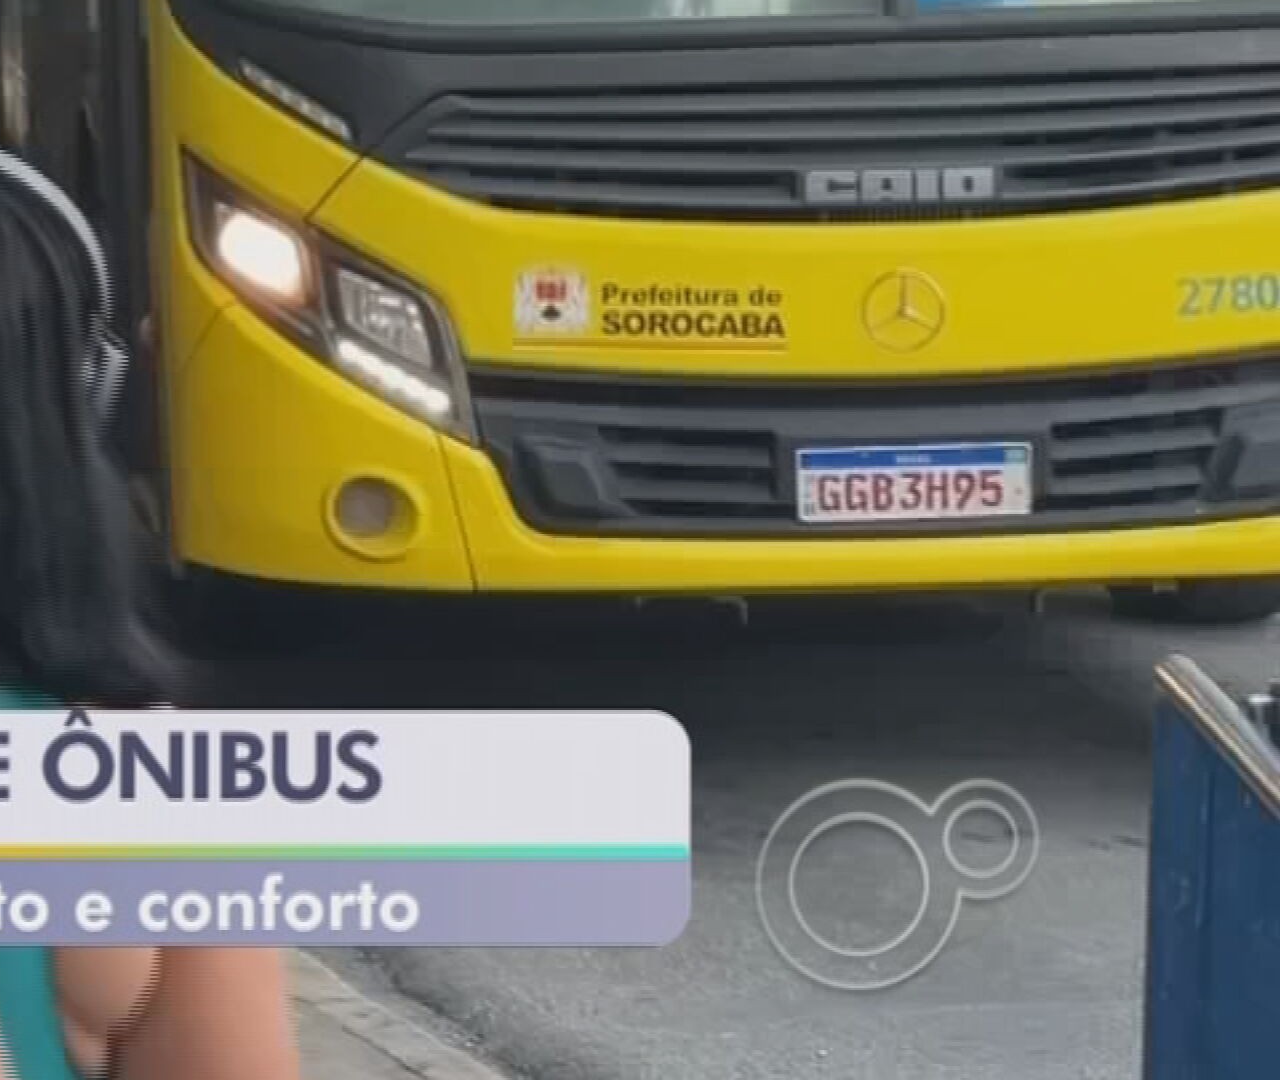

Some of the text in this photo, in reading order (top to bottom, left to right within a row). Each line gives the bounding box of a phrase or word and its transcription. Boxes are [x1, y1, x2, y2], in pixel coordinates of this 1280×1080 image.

[806, 167, 994, 203] CAIO
[601, 282, 782, 307] Prefeitura de
[601, 310, 786, 338] SOROCABA
[817, 469, 1005, 512] GGB3H95
